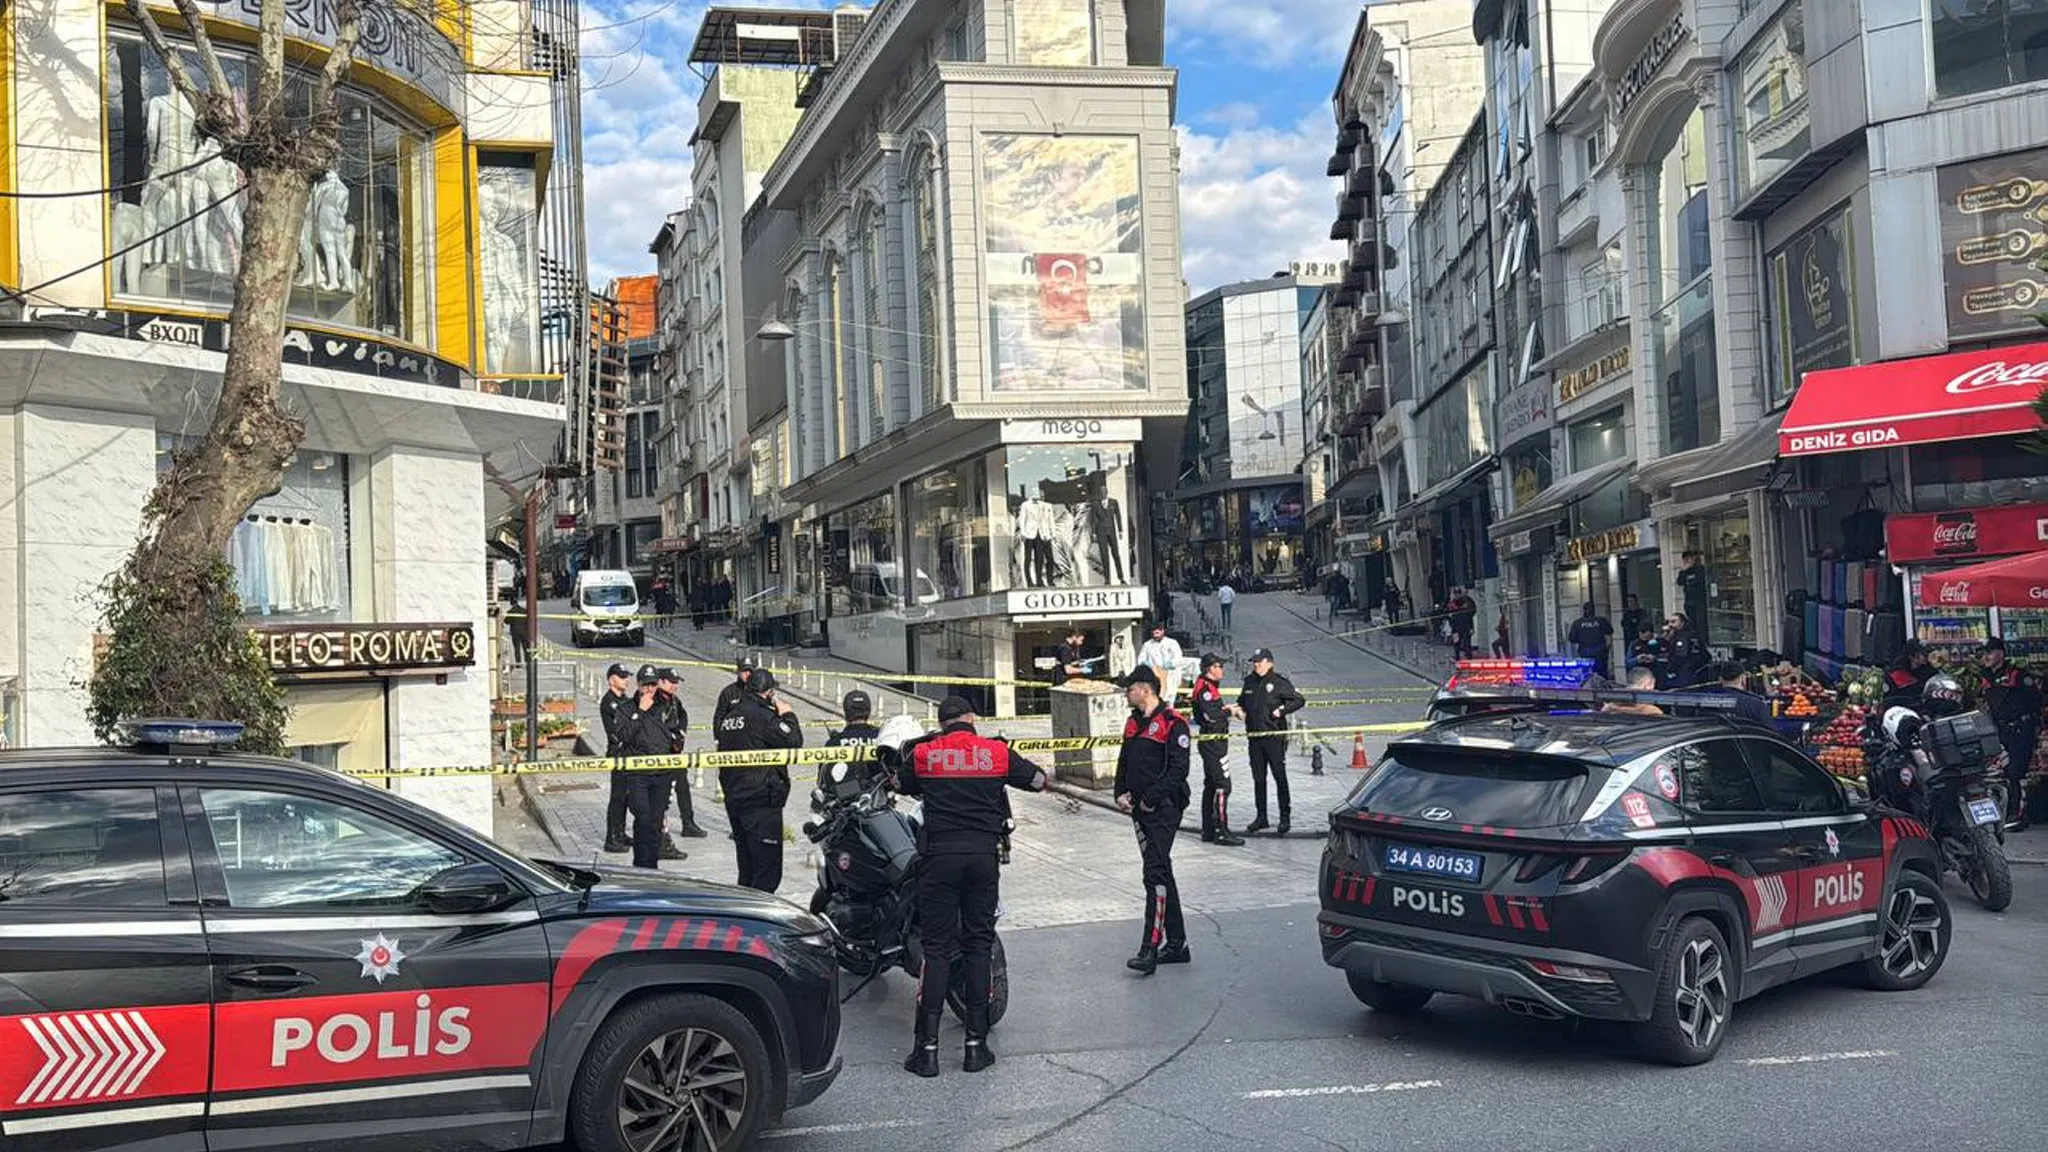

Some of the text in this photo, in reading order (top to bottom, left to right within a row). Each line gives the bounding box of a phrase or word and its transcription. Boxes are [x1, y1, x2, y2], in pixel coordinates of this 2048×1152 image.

[150, 323, 200, 346] ВХОД
[1042, 419, 1102, 439] mega
[1790, 426, 1900, 452] DENİZ GIDA
[1025, 590, 1133, 610] GIOBERTI
[350, 630, 439, 663] ROMA
[1389, 848, 1474, 874] 34 A 80153
[1814, 863, 1865, 909] POLİS
[271, 993, 472, 1067] POLİS
